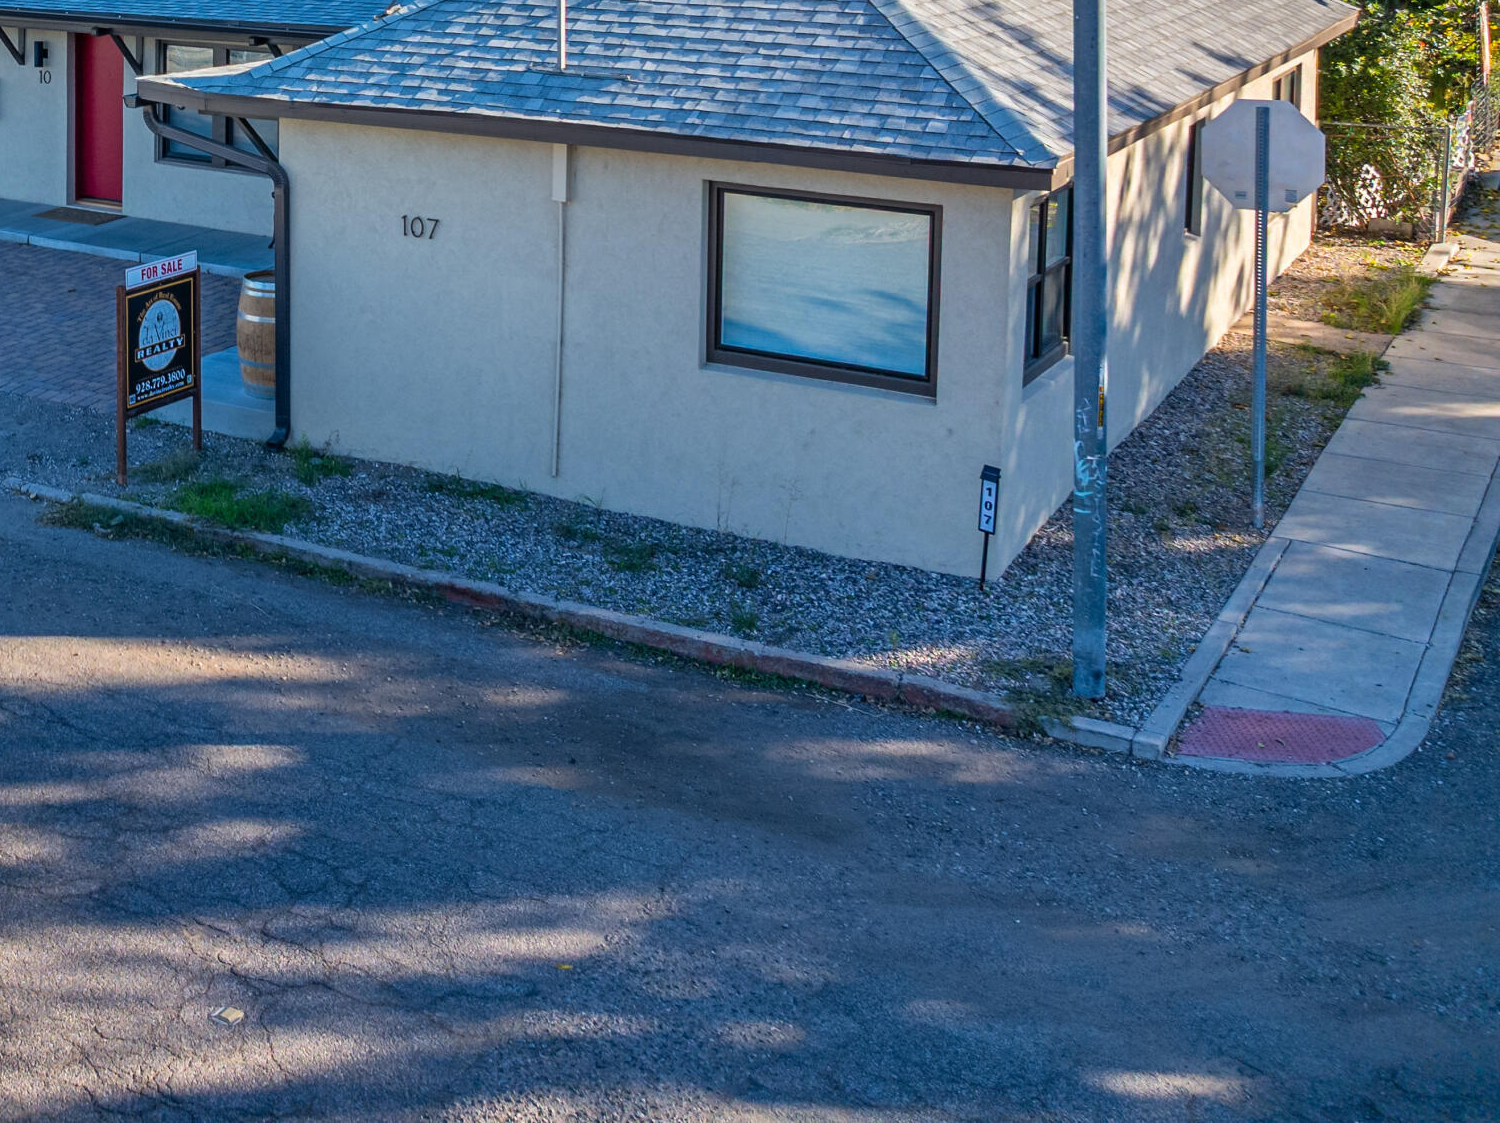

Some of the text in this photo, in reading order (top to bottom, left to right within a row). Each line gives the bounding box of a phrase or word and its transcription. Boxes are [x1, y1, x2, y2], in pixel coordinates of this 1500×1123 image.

[39, 70, 52, 84] 10
[401, 215, 440, 239] 107
[141, 259, 183, 281] FOR SALE
[137, 337, 184, 359] REALTY
[136, 368, 186, 394] 928.779.3800
[984, 487, 993, 526] 107
